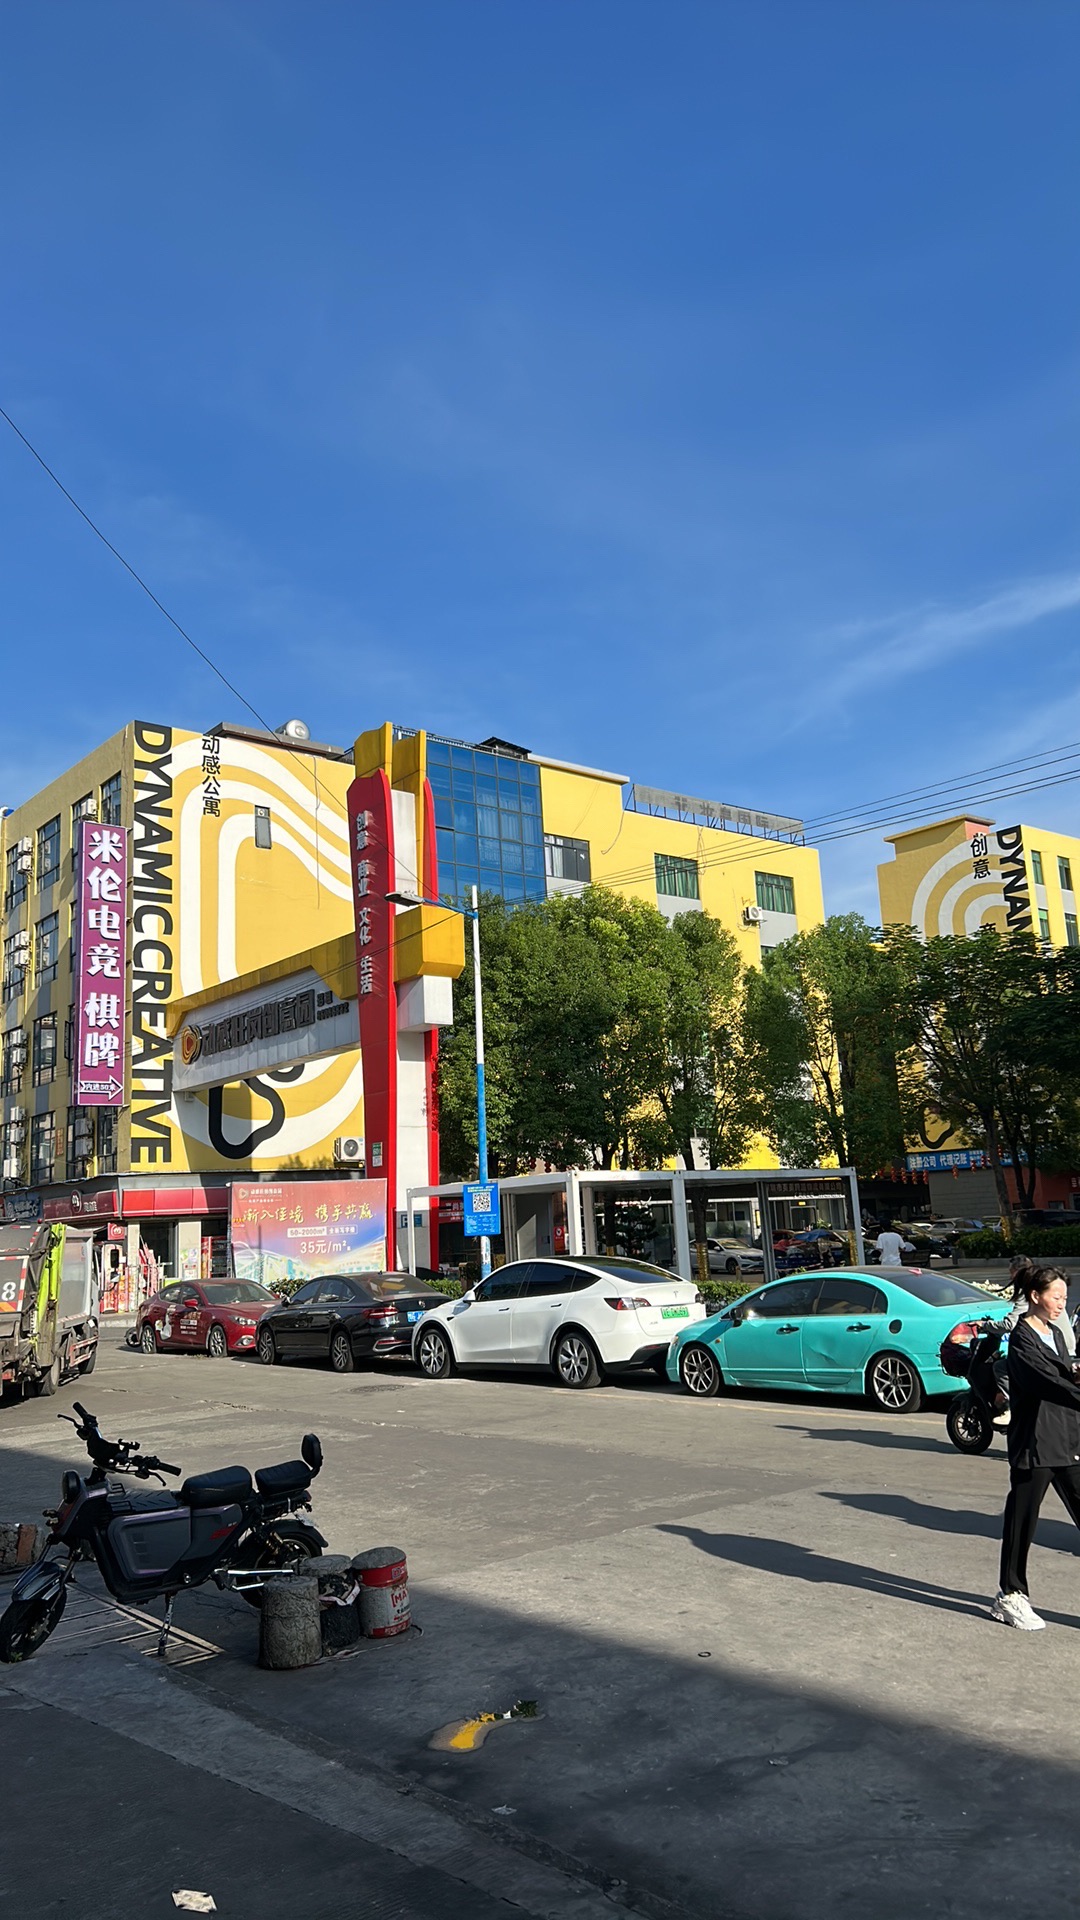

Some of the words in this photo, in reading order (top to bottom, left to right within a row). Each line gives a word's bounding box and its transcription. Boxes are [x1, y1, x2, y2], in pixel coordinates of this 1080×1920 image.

[201, 734, 221, 817] 动感公寓
[356, 810, 369, 851] 创意
[970, 832, 991, 880] 创意
[357, 859, 371, 897] 商业
[86, 830, 124, 979] 米伦电竞
[131, 720, 173, 1162] DYNAMICCREATIVE
[358, 907, 373, 946] 文化
[360, 955, 374, 995] 生活
[84, 993, 121, 1068] 棋牌
[243, 1204, 304, 1225] 渐入佳境
[1, 1281, 17, 1302] 8
